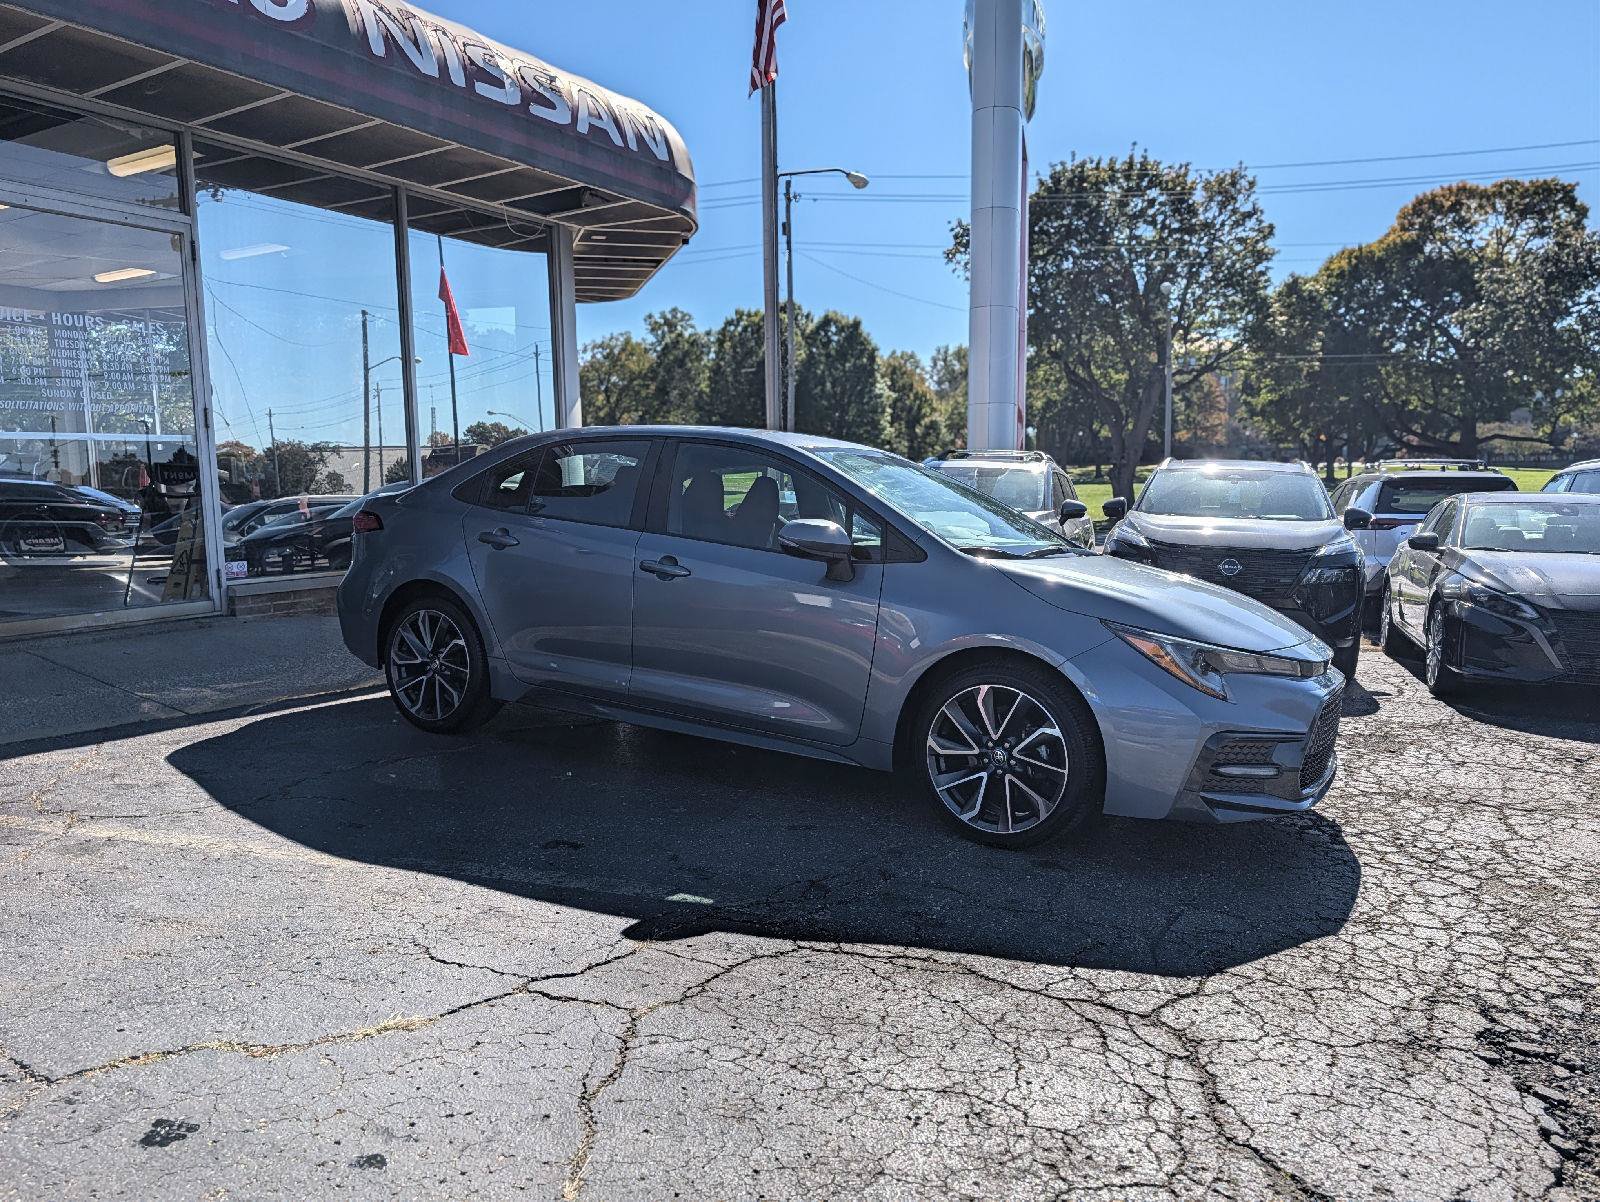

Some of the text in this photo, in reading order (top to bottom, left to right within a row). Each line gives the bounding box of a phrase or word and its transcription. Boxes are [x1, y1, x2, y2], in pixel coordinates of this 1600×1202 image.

[358, 0, 669, 161] NISSAN
[51, 312, 104, 330] HOURS
[122, 319, 166, 335] SALES
[54, 329, 89, 340] MONDAY
[53, 338, 90, 350] TUESDAY
[49, 348, 95, 360] WEDNESDAY
[51, 358, 93, 370] THURSDAY
[120, 362, 133, 372] AM
[33, 367, 46, 376] PM
[61, 369, 88, 379] FRIDAY
[103, 371, 121, 380] 9:00
[122, 372, 134, 381] AM
[159, 374, 171, 384] PM
[34, 377, 47, 387] PM
[123, 382, 136, 391] AM
[41, 388, 112, 400] SUNDAY COSED
[0, 400, 65, 412] SOLICITATIONS
[68, 402, 106, 414] WITOUT
